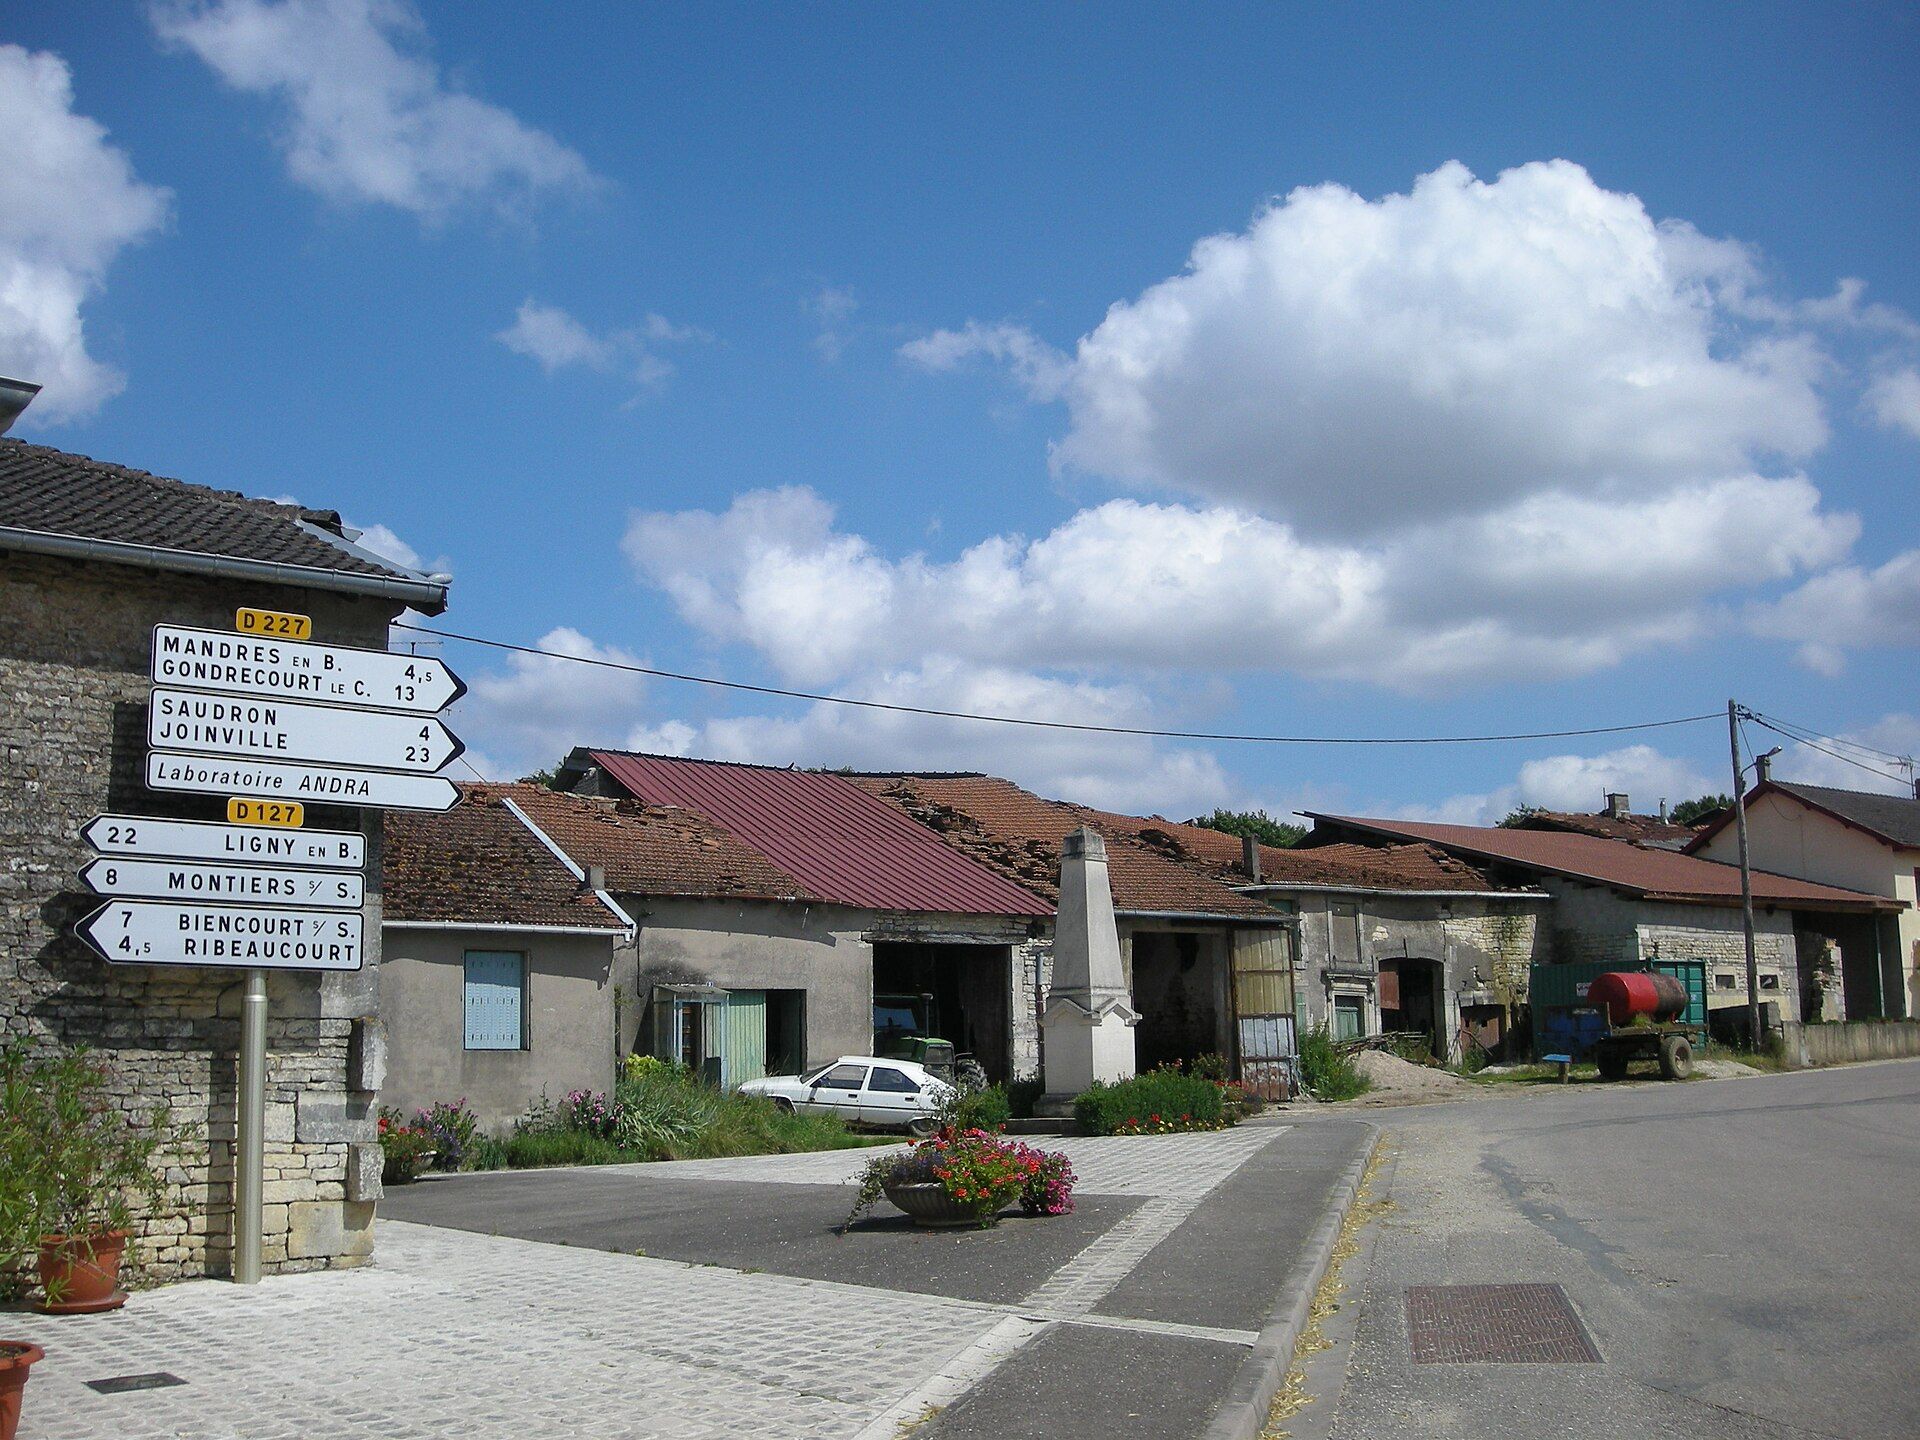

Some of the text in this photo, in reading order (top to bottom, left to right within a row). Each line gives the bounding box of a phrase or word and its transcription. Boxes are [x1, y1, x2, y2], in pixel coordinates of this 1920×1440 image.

[243, 613, 305, 635] D 227
[163, 635, 432, 684] MANDRES EN B. 4,5
[162, 658, 415, 702] GONDRECOURT LE C. 13
[161, 698, 430, 742] SAUDRON 4
[159, 721, 430, 763] JOINVILLE 23
[157, 761, 370, 796] Laboratoire ANDRA
[236, 802, 296, 823] D 127
[107, 826, 357, 860] 22 LIGNY EN B.
[105, 868, 118, 886] 8
[168, 871, 296, 896] MONTIERS
[336, 882, 356, 900] S.
[121, 911, 133, 929] 7
[178, 913, 304, 938] BIENCOURT
[337, 921, 355, 939] S.
[118, 935, 355, 963] 4,5 RIBEAUCOURT
